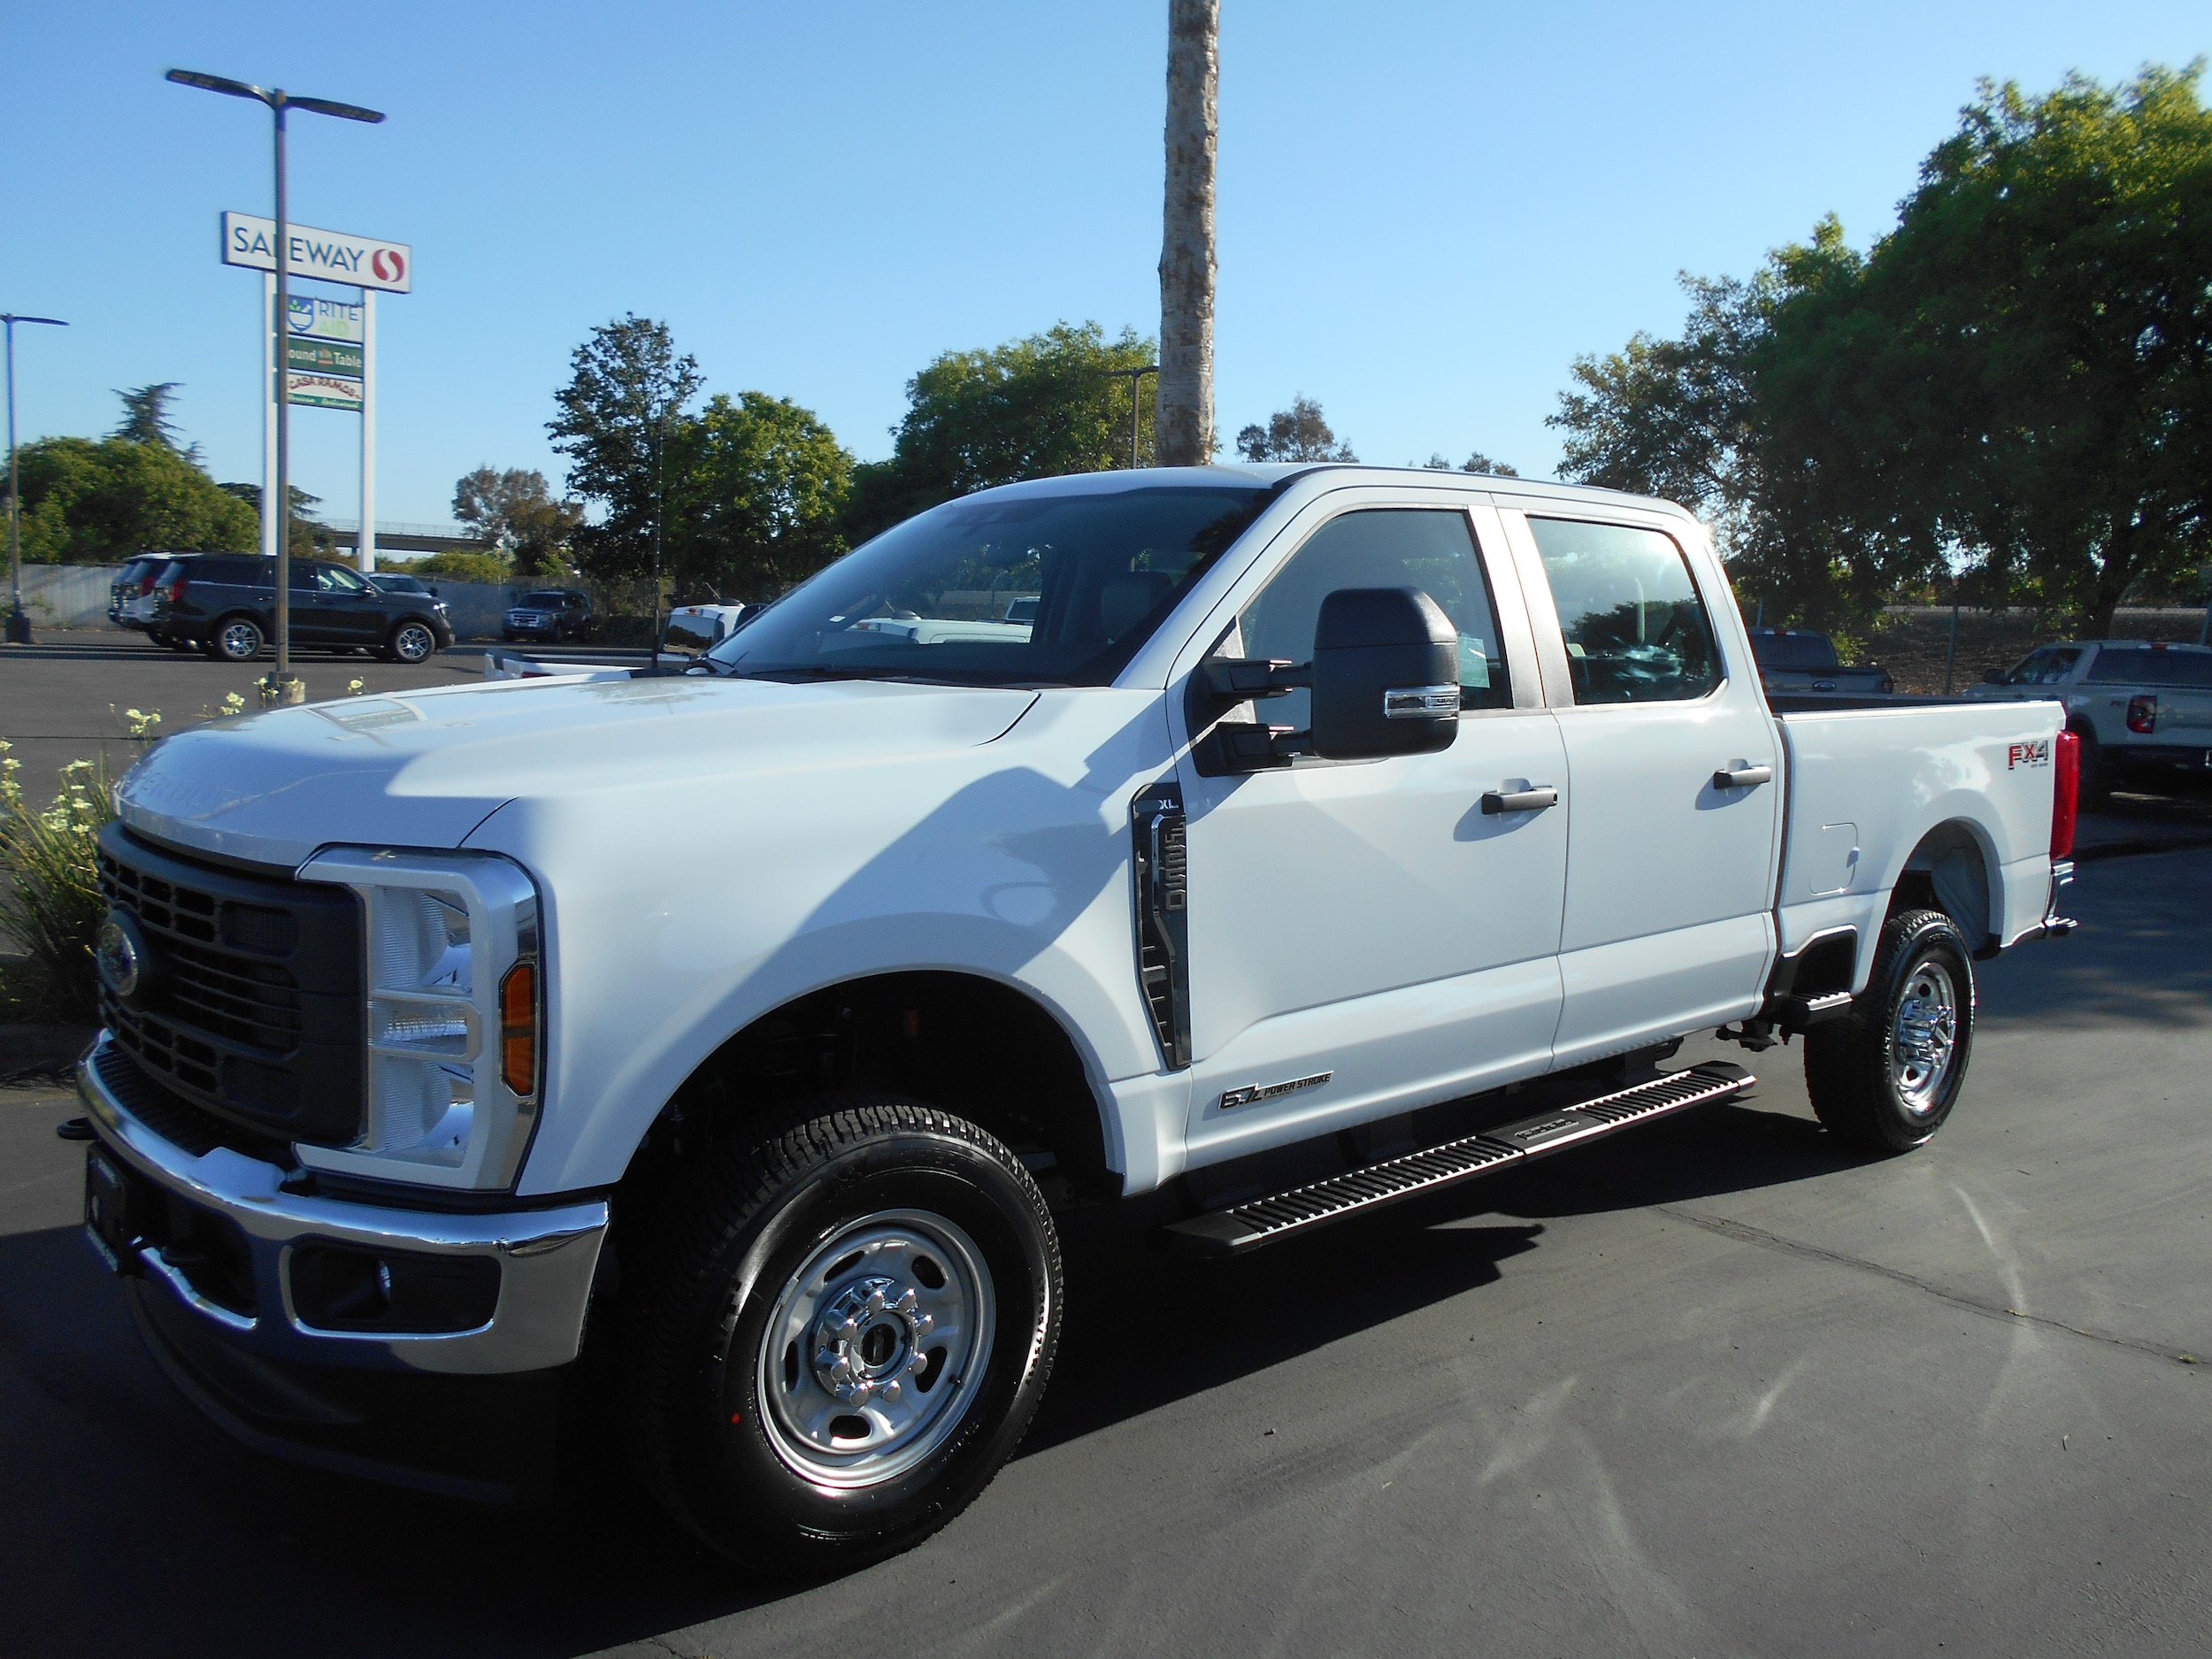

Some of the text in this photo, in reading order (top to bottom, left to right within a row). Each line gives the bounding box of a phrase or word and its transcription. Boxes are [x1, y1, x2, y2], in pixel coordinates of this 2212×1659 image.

[234, 227, 365, 273] SAEWAY
[318, 302, 358, 321] RITE
[319, 319, 349, 336] AID
[288, 349, 362, 368] ound Table
[2008, 740, 2048, 770] FX4
[1159, 799, 1179, 810] XL
[1263, 1081, 1295, 1096] POWER
[1296, 1072, 1332, 1088] STROKE
